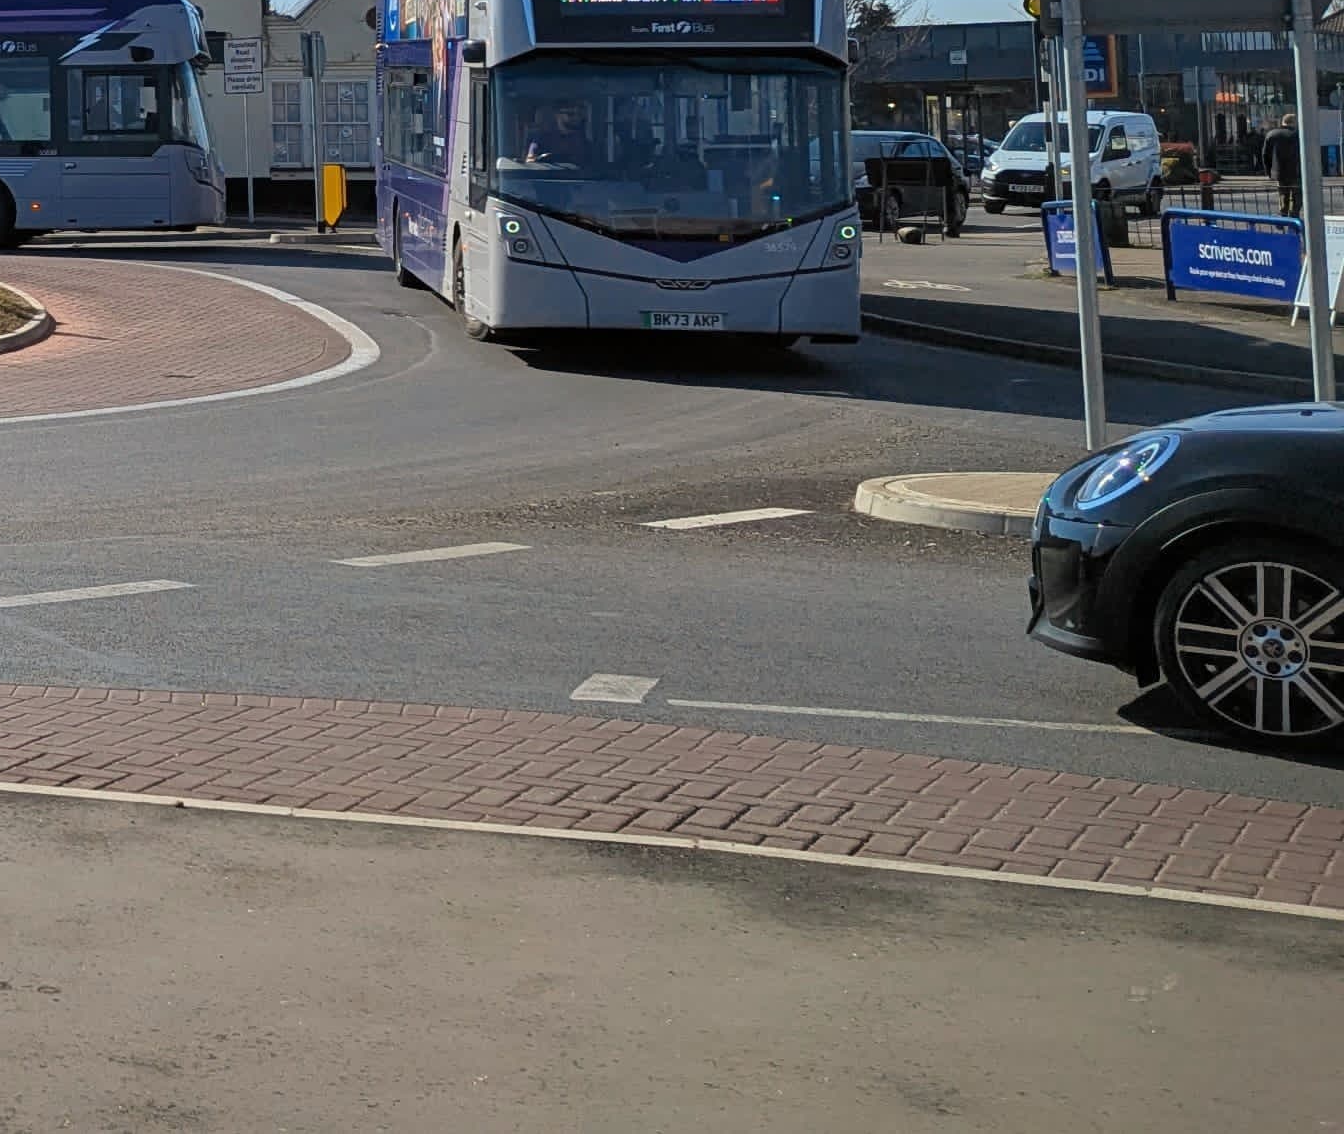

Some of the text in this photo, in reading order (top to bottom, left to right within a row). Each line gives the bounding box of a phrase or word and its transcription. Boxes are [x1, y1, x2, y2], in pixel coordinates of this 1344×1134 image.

[651, 22, 676, 33] First
[692, 22, 715, 33] Bus
[1198, 239, 1273, 267] scrivens.com
[653, 313, 721, 327] BK73 AKP
